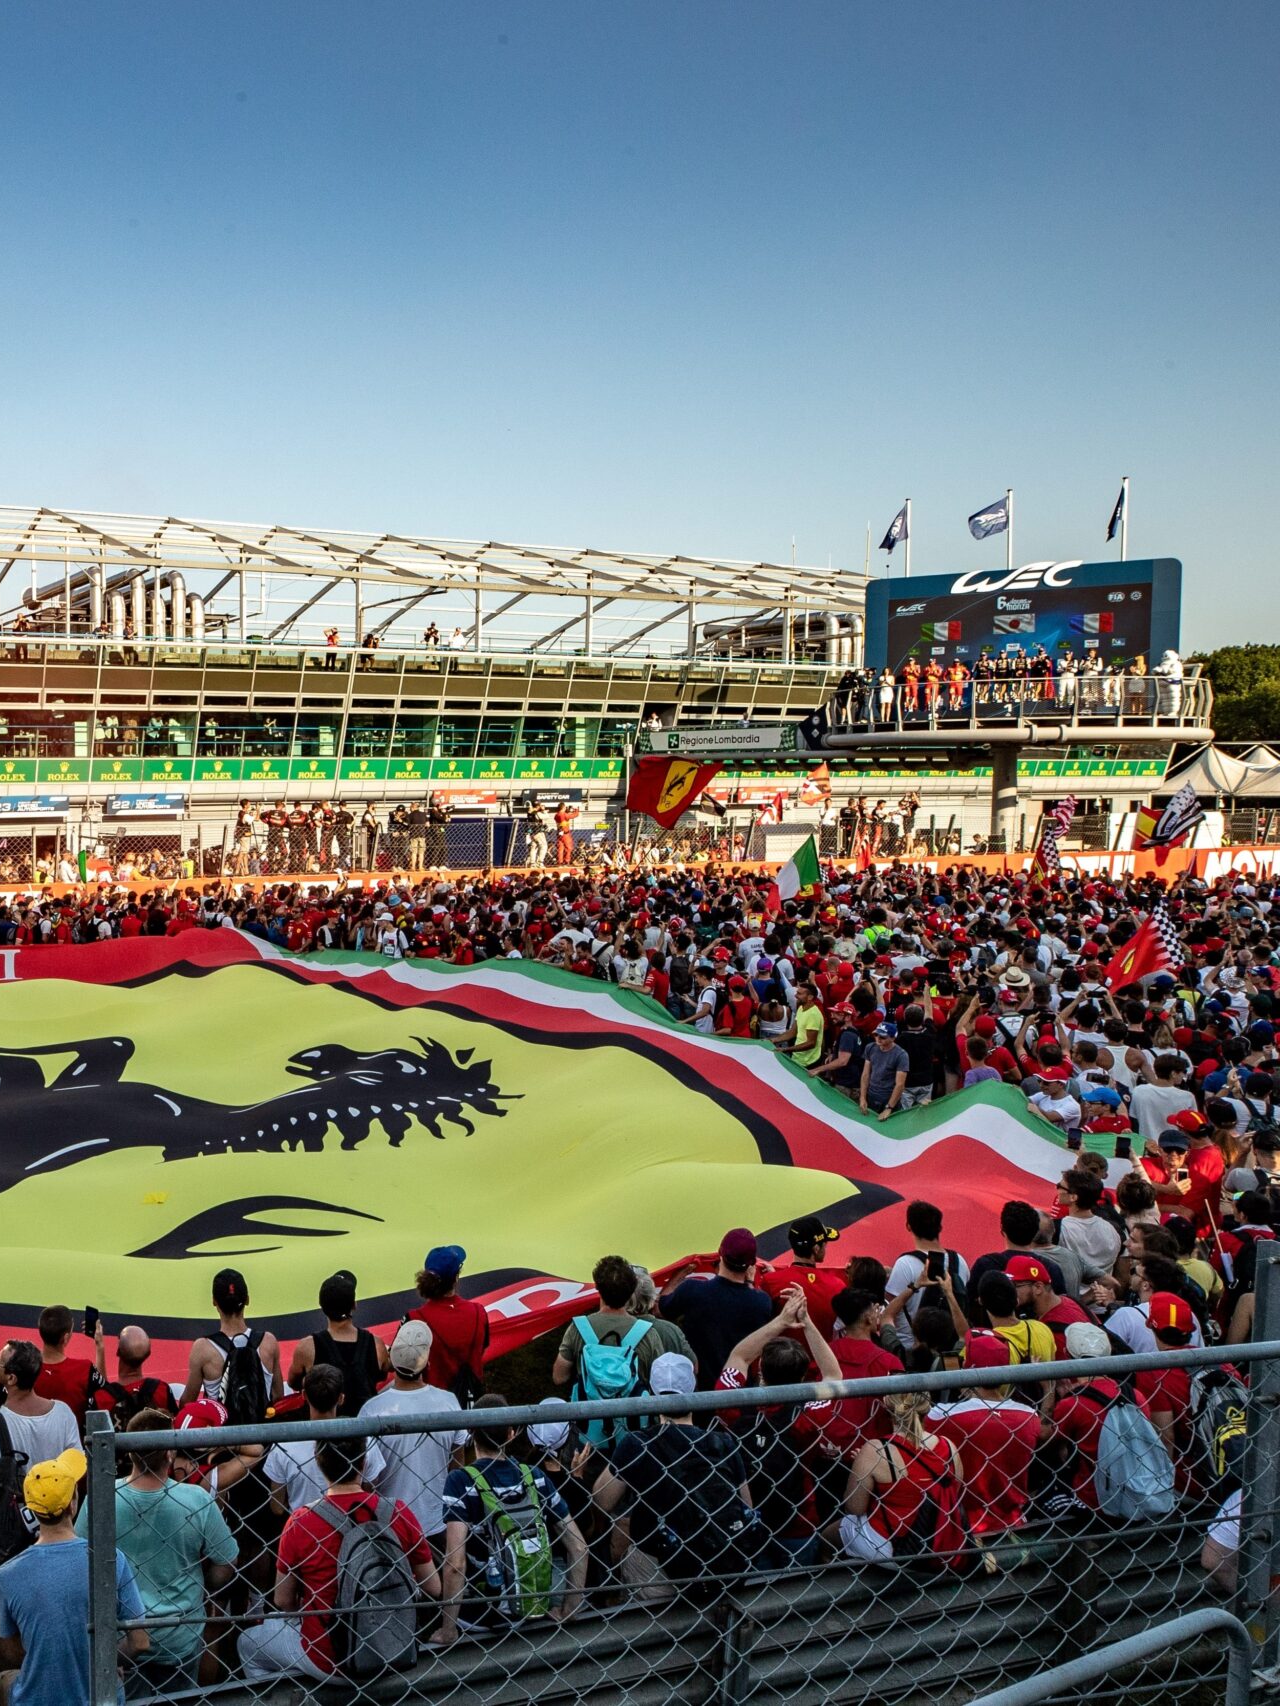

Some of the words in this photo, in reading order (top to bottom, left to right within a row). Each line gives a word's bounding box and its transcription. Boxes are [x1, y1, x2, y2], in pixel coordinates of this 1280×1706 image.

[950, 560, 1083, 593] WEC
[997, 596, 1008, 610] 6
[896, 603, 927, 612] WEC
[681, 736, 713, 746] Regione
[714, 735, 760, 744] Lombardia
[47, 773, 80, 781] ROLEX
[100, 773, 132, 781] ROLEX
[151, 773, 182, 781] ROLEX
[202, 773, 231, 781] ROLEX
[298, 772, 325, 780] ROLEX
[598, 771, 621, 779] ROLEX
[112, 801, 130, 809] 22
